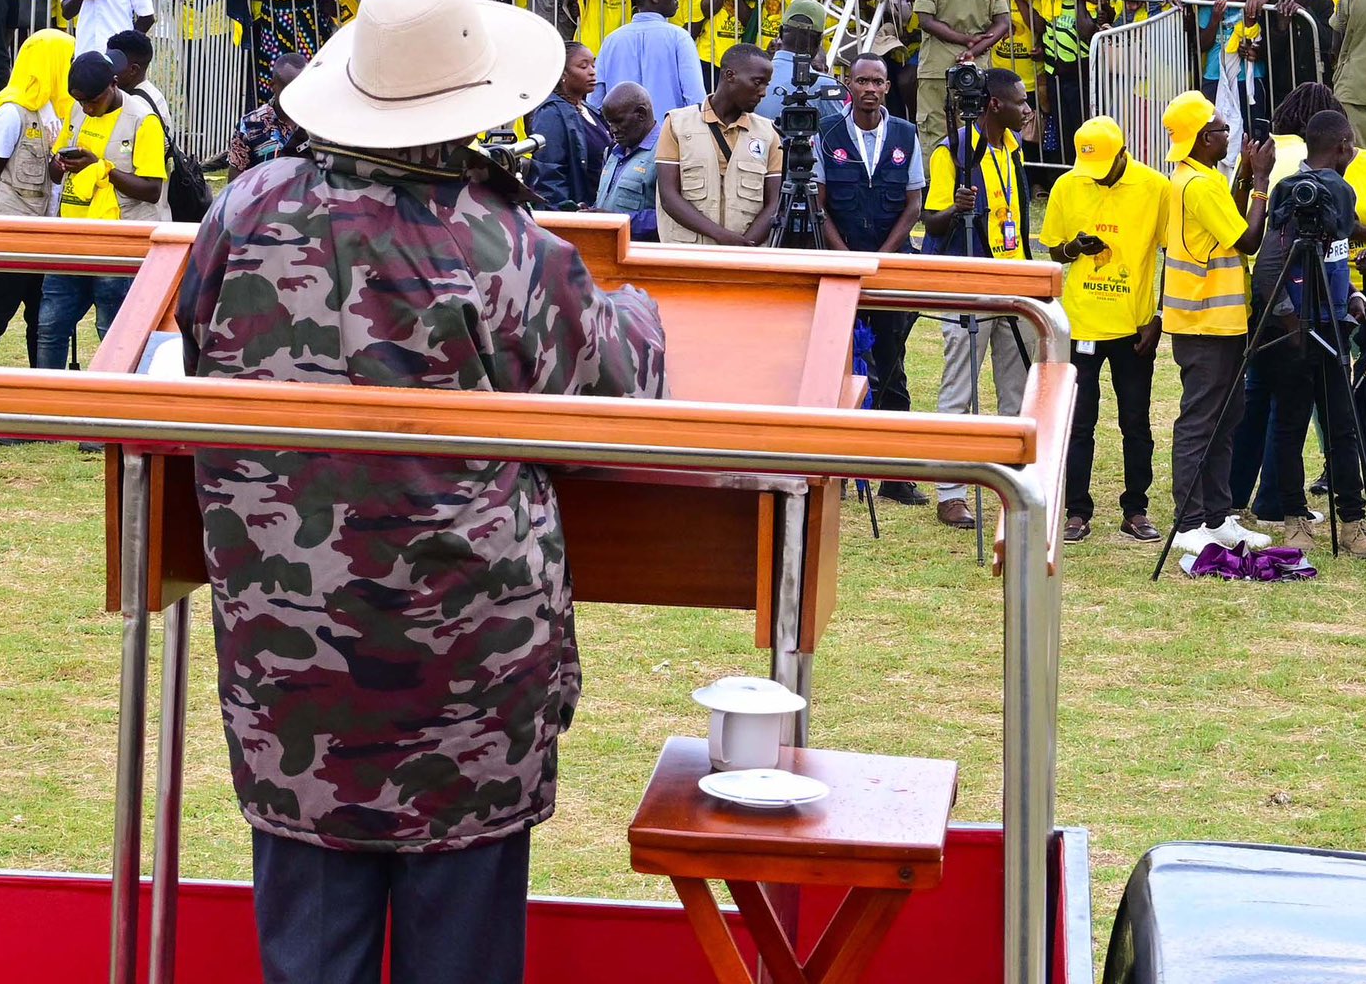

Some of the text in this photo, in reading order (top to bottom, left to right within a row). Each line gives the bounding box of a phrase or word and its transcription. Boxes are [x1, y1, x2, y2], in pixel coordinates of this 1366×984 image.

[1095, 223, 1119, 234] VOTE
[1327, 242, 1348, 258] PRES
[1083, 282, 1131, 294] MUSEVENI
